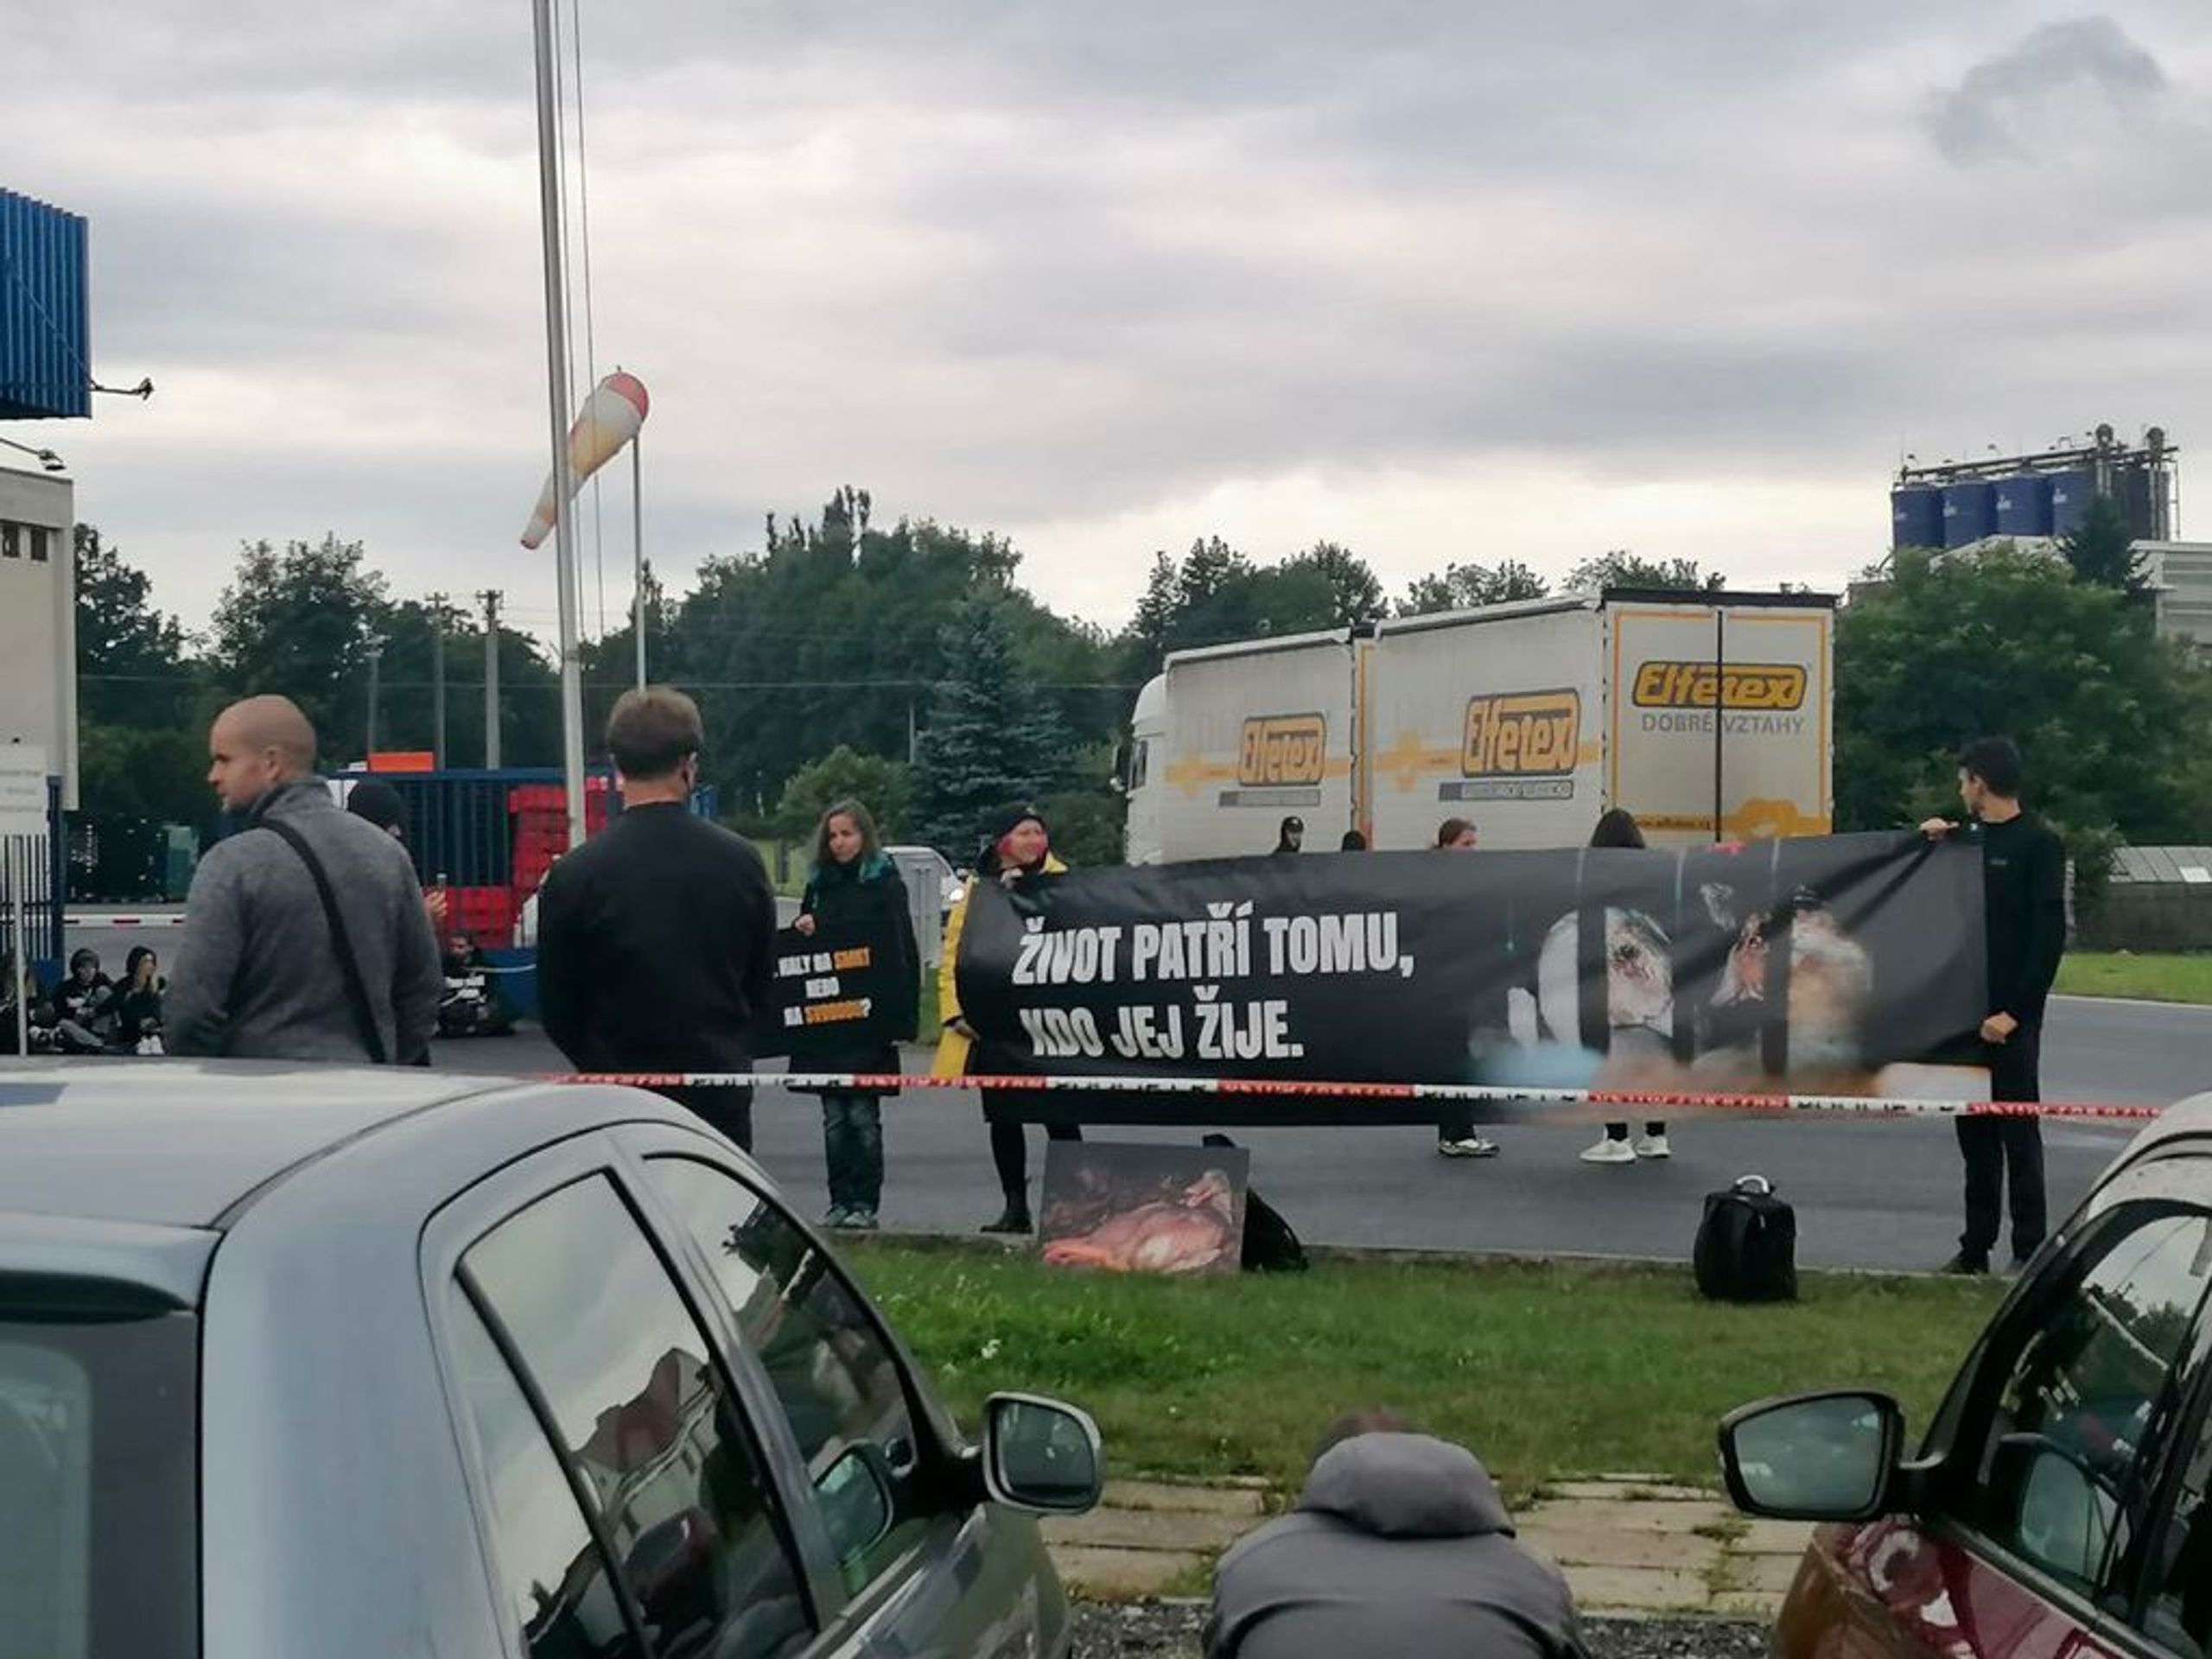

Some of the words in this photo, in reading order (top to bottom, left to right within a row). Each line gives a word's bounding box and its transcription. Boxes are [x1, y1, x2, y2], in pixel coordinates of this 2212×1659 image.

[1642, 710, 1714, 732] DOBRÉ
[1722, 714, 1803, 734] VZTAHY
[1012, 916, 1122, 985] ŽIVOT
[1133, 900, 1254, 982] PATŘÍ
[1263, 912, 1414, 978] TOMU,
[1020, 1006, 1105, 1058] KDO
[1110, 1004, 1185, 1058] JEJ
[1192, 984, 1304, 1059] ŽIJE.
